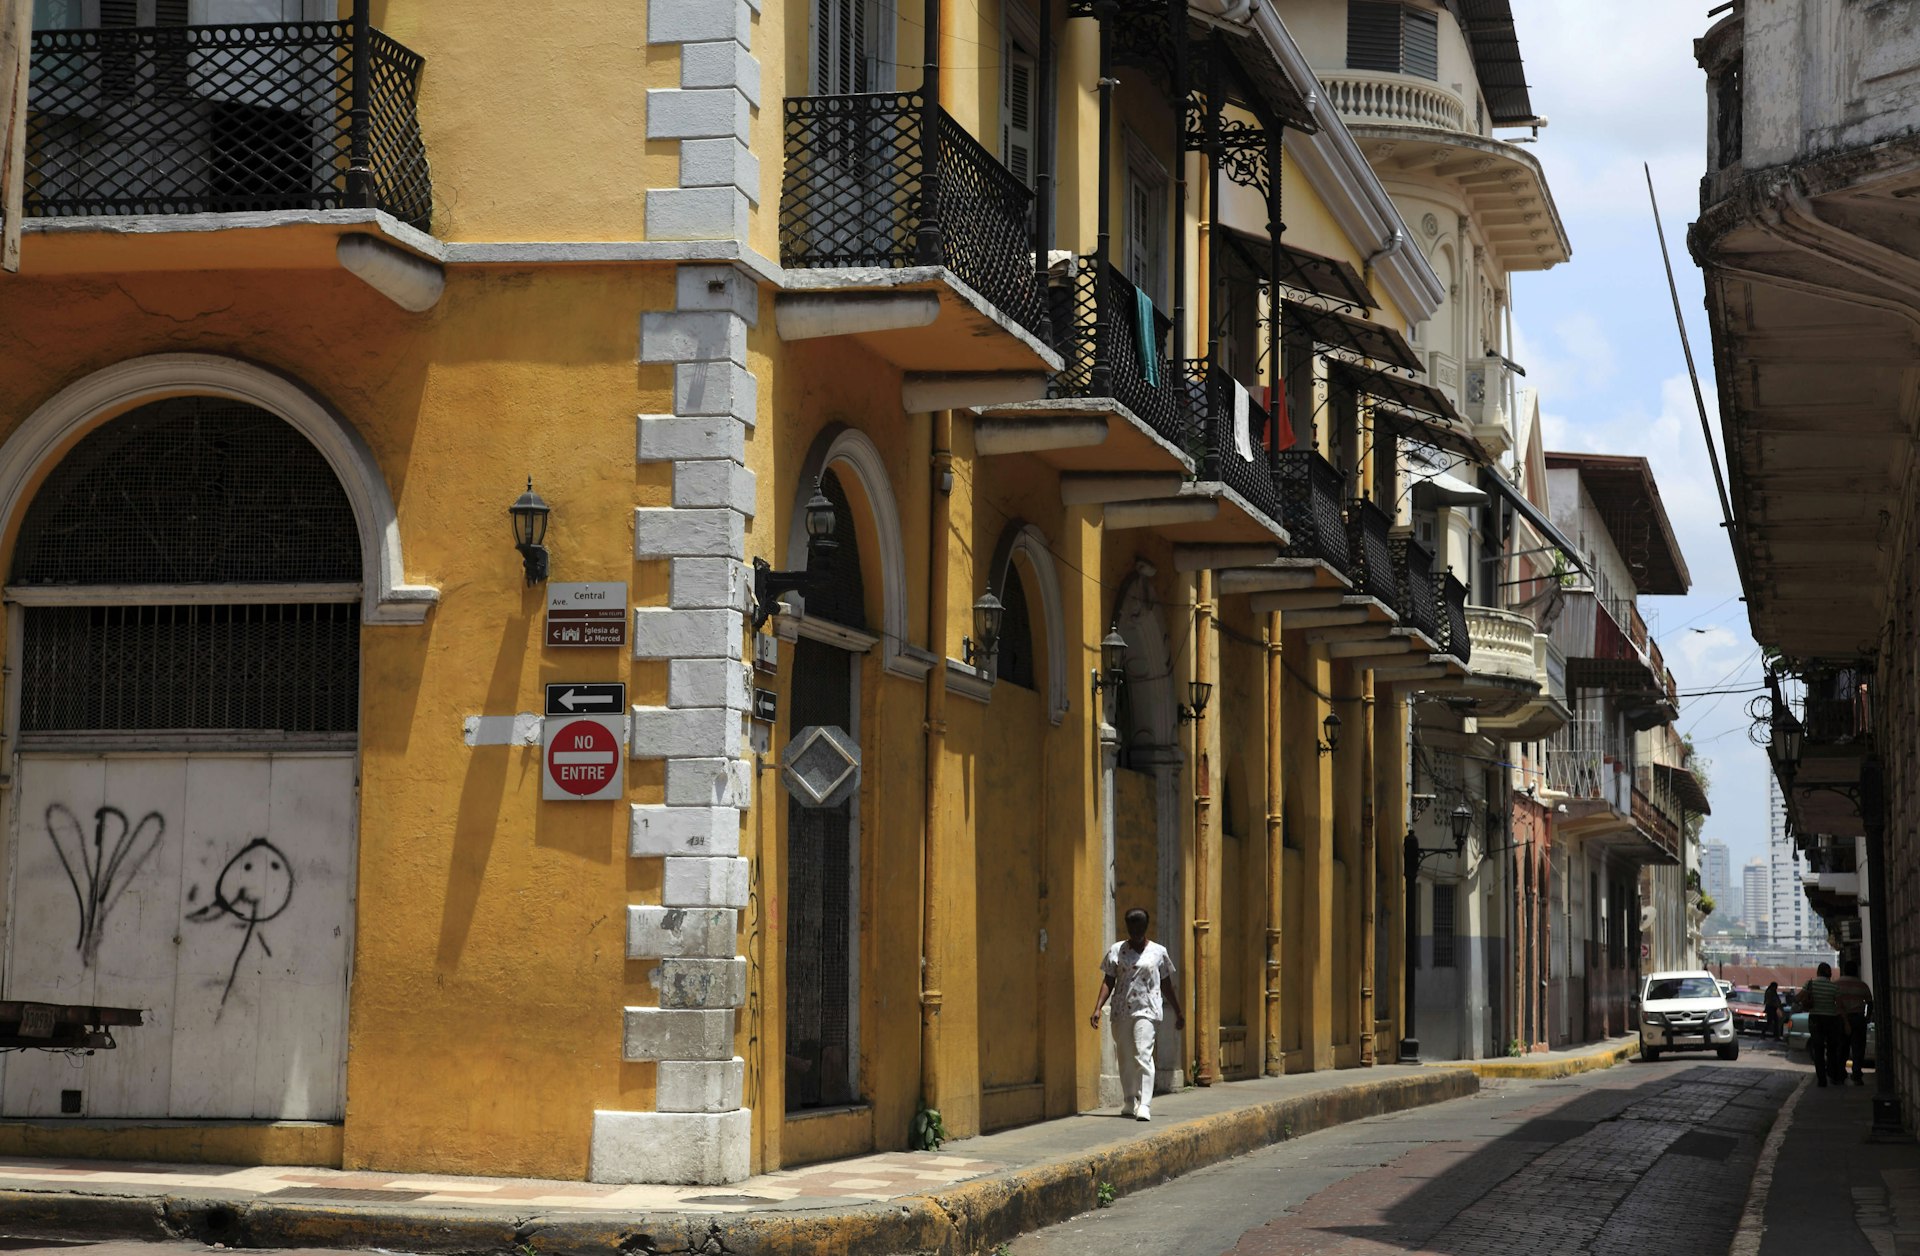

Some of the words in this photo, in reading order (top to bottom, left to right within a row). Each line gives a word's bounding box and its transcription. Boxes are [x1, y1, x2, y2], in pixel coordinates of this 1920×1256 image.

[574, 591, 606, 600] Central
[584, 627, 608, 635] Iglesia
[574, 735, 594, 749] NO
[561, 766, 605, 780] ENTRE
